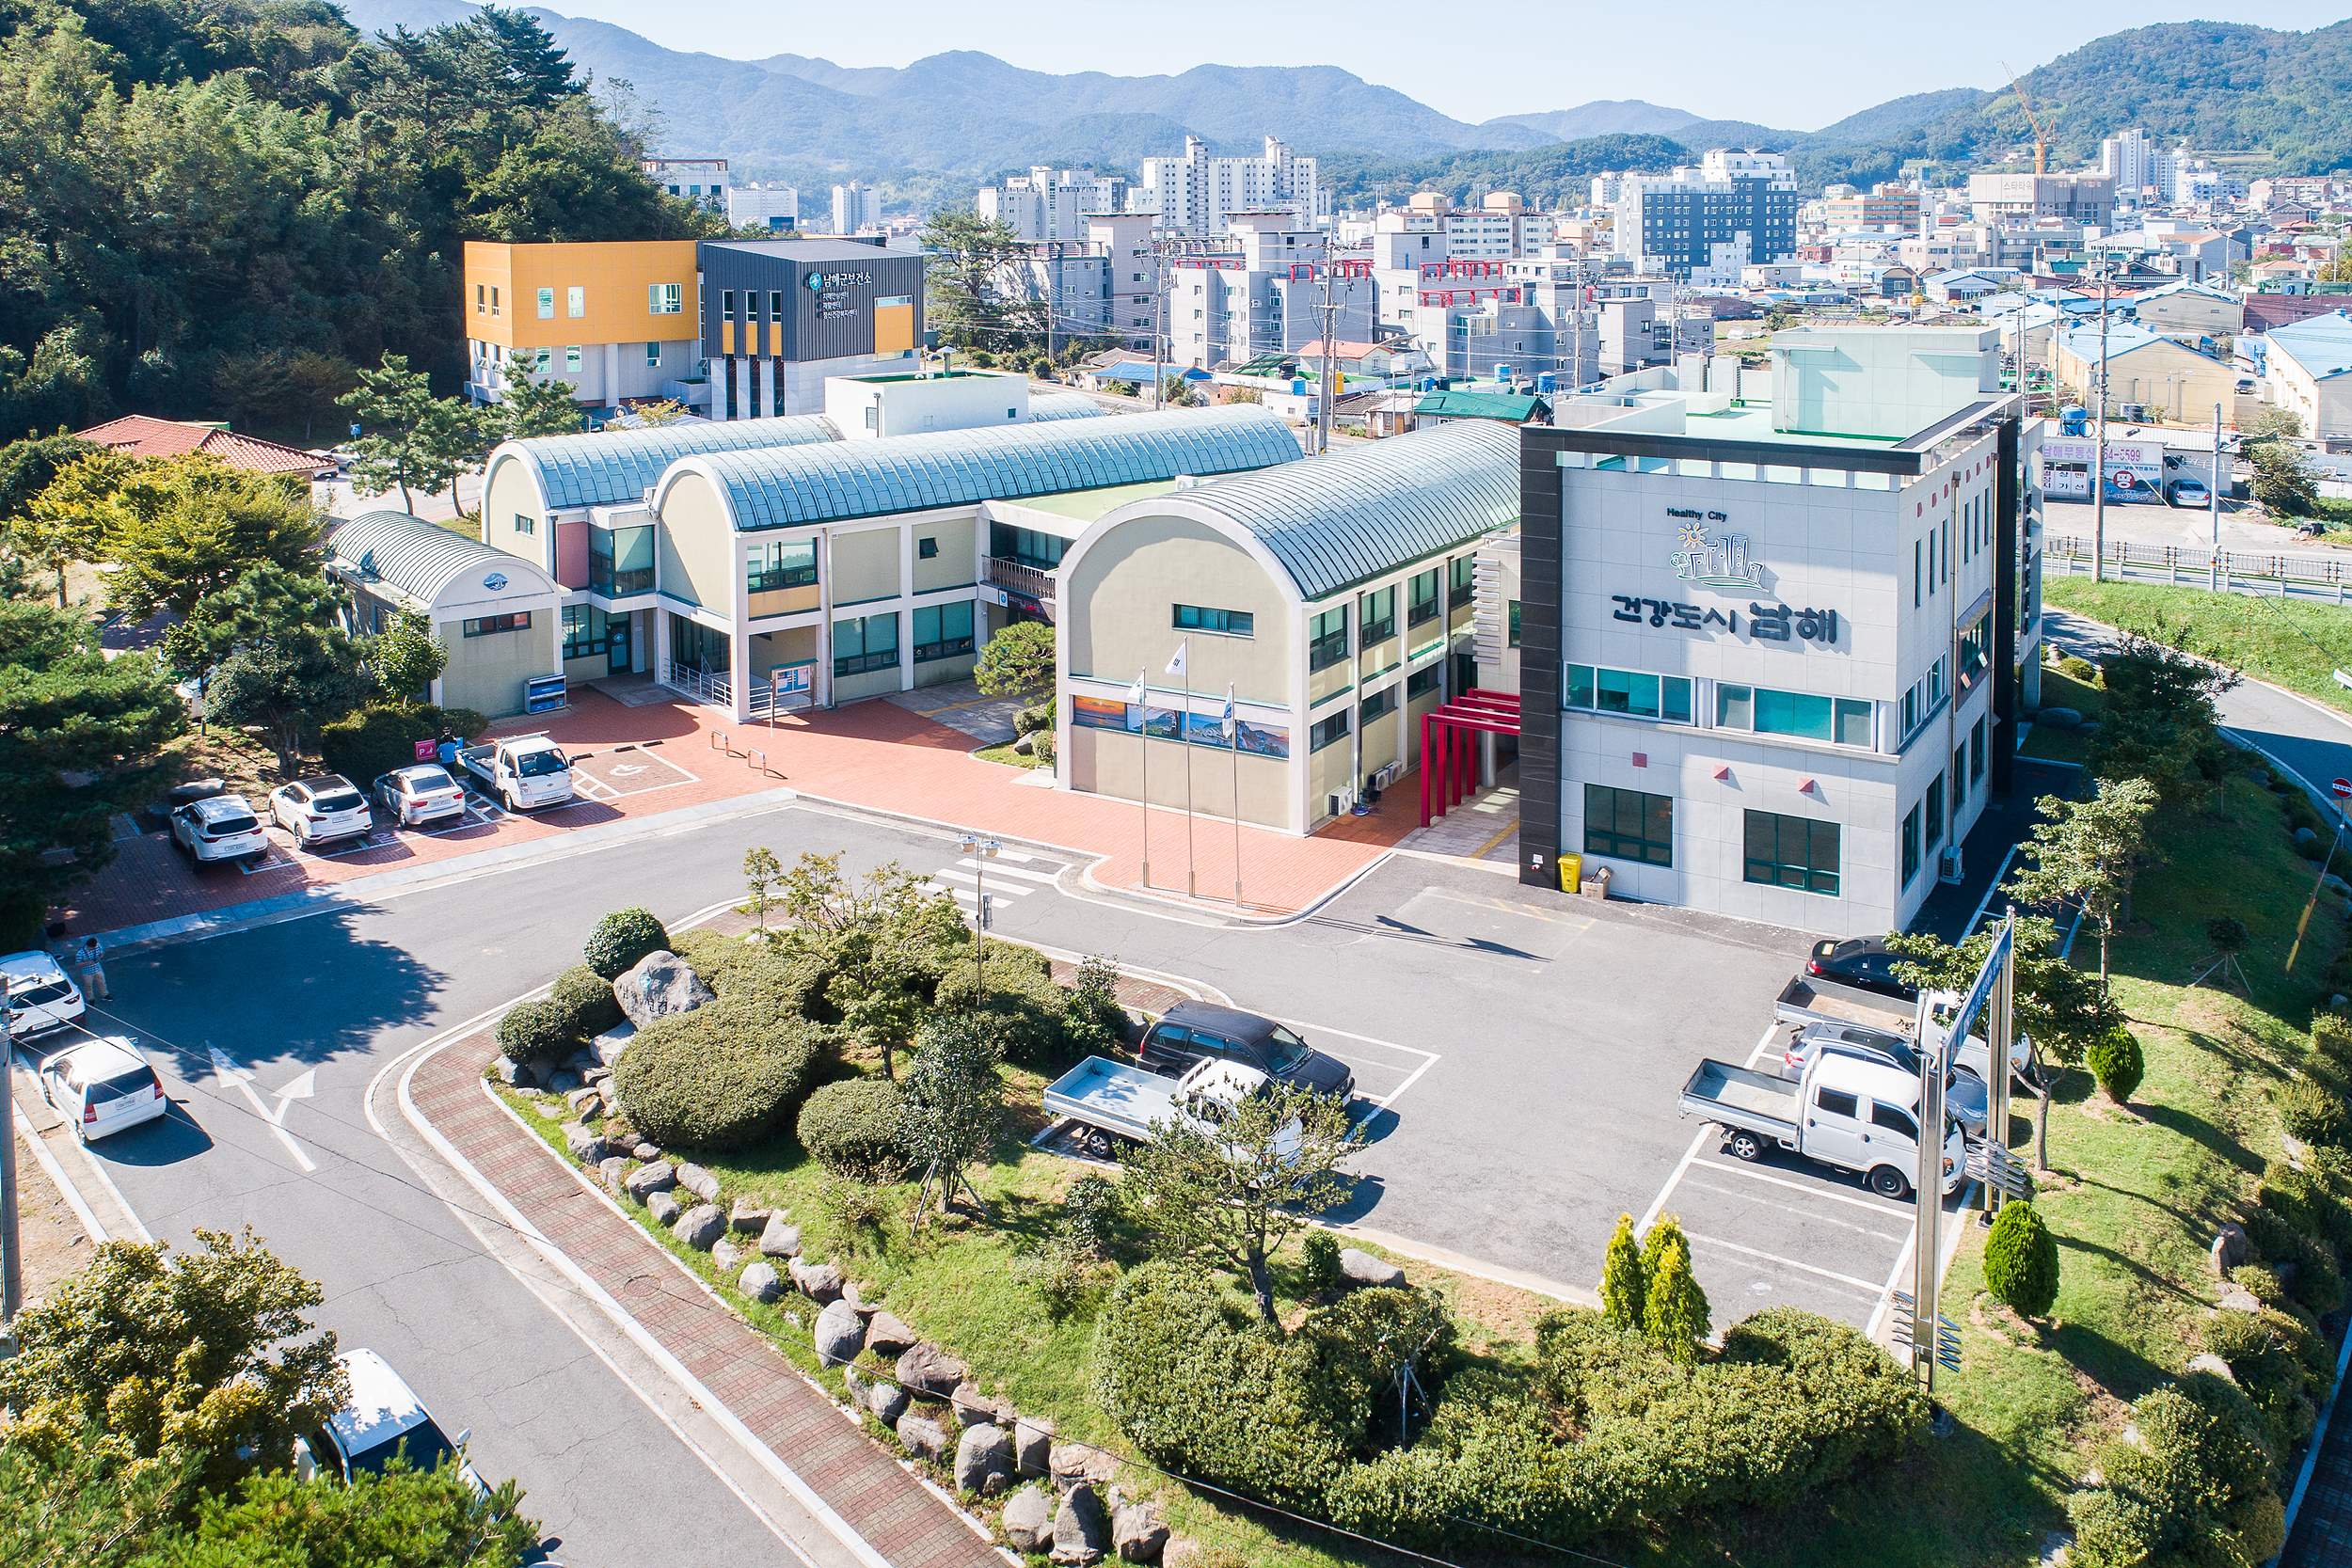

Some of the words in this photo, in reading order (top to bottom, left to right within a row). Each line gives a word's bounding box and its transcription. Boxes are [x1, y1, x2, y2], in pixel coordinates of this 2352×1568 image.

[823, 272, 872, 288] 남해군보건소
[1666, 507, 1703, 520] Healthy
[1708, 511, 1727, 522] City
[1612, 595, 1736, 633] 건강도시
[1749, 602, 1836, 643] 남해
